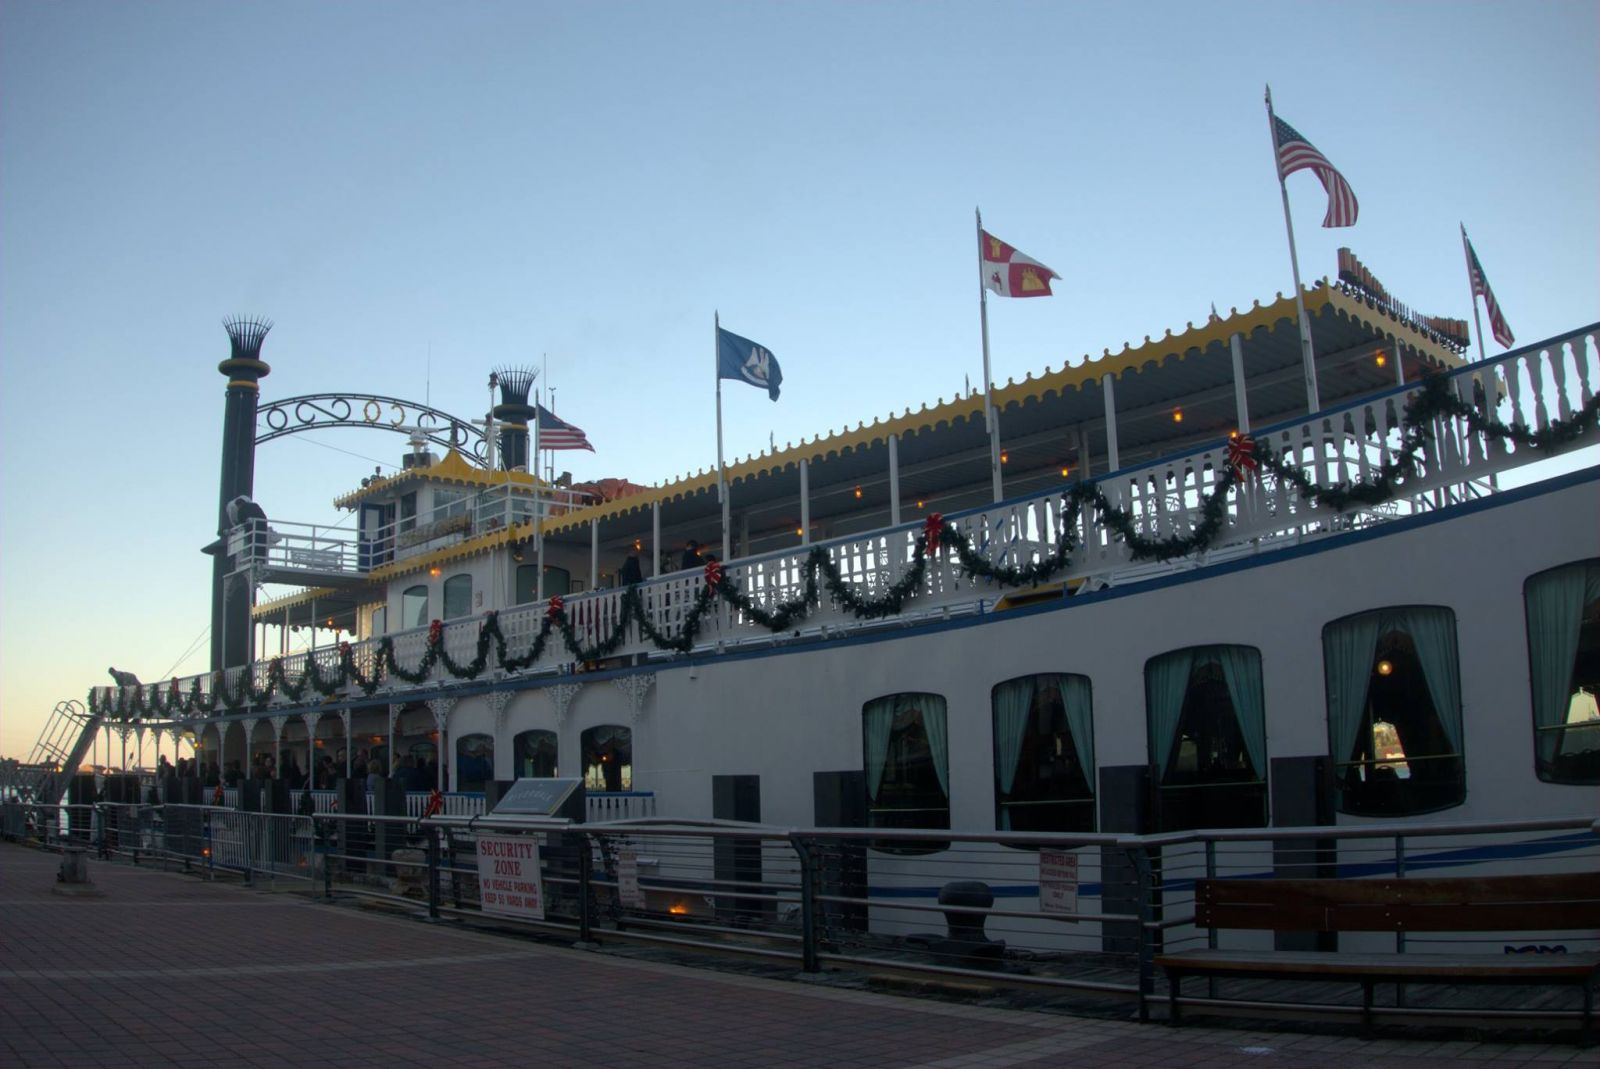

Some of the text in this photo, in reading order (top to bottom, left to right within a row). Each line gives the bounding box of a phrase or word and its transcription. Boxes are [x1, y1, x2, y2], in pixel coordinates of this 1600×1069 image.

[480, 840, 532, 859] SECURITY
[494, 860, 522, 876] ZONE
[483, 879, 537, 894] NO VEHICLE PARKING
[484, 892, 497, 904] KEEP
[507, 895, 523, 908] YARDS
